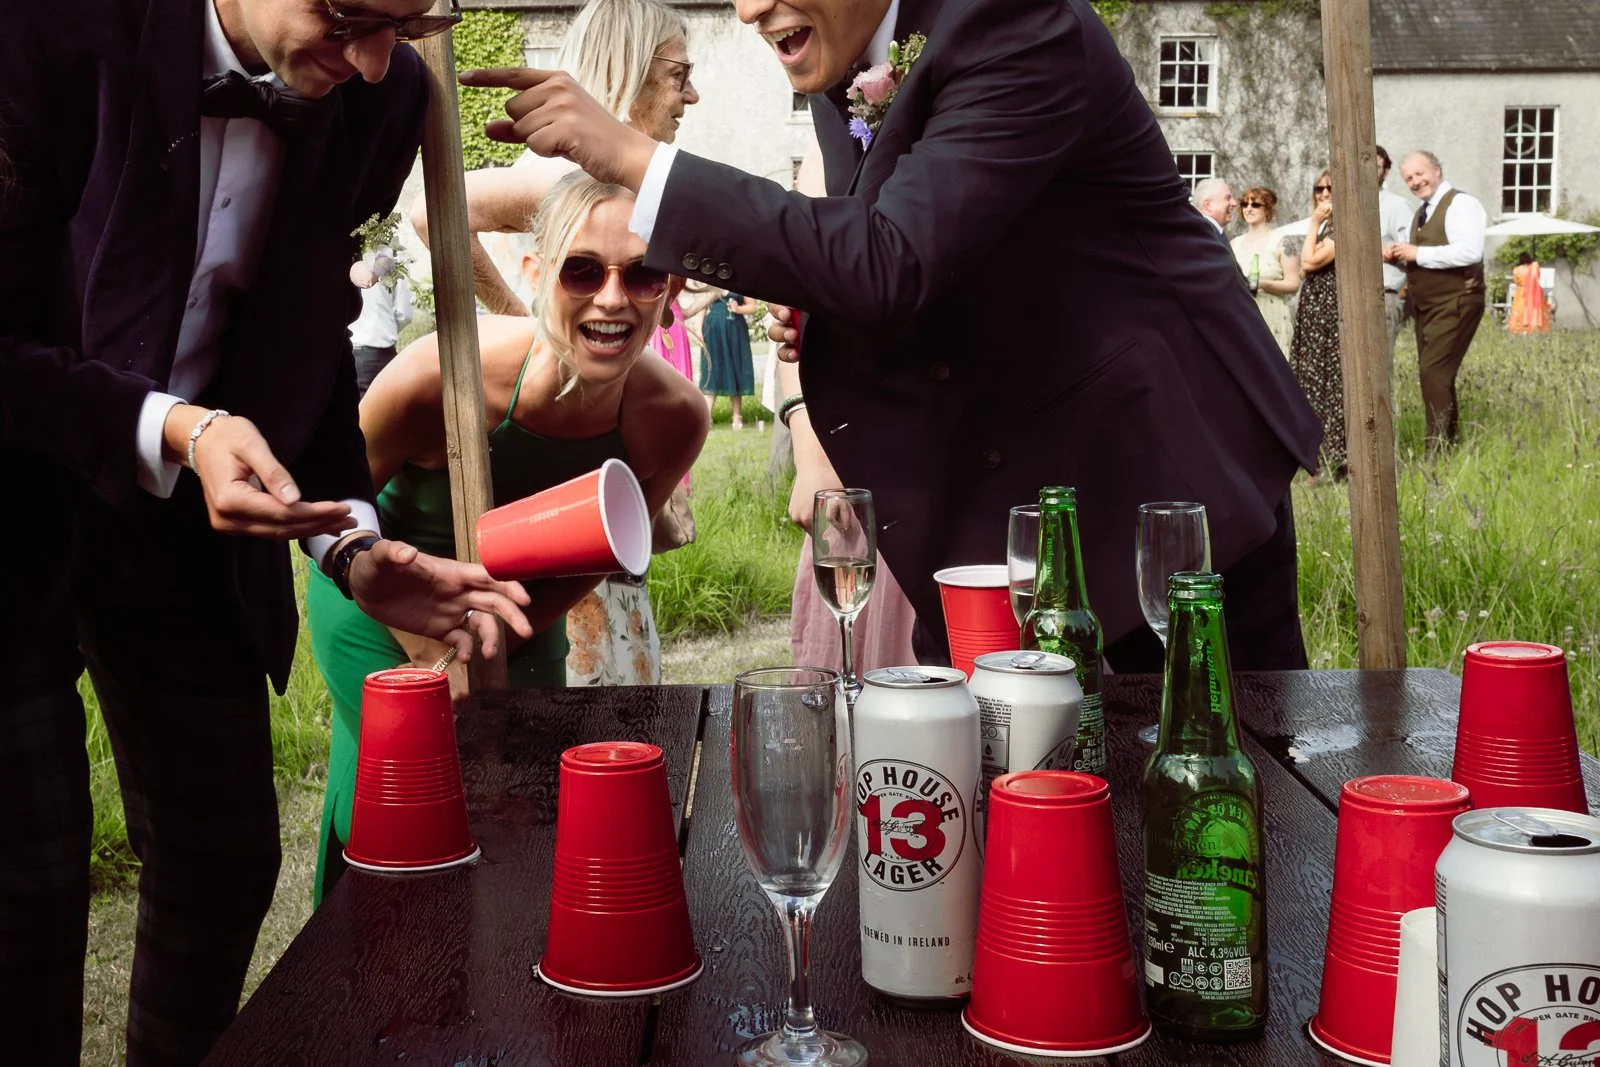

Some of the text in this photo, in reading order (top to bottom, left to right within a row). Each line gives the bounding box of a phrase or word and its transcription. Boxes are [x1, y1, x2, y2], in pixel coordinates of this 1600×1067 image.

[882, 766, 960, 823] HOUSE
[857, 794, 946, 862] 13
[863, 851, 944, 885] LAGER
[864, 925, 950, 948] BREWED IN IRELAND
[1188, 946, 1208, 958] ALC.
[1466, 982, 1521, 1046] HOP
